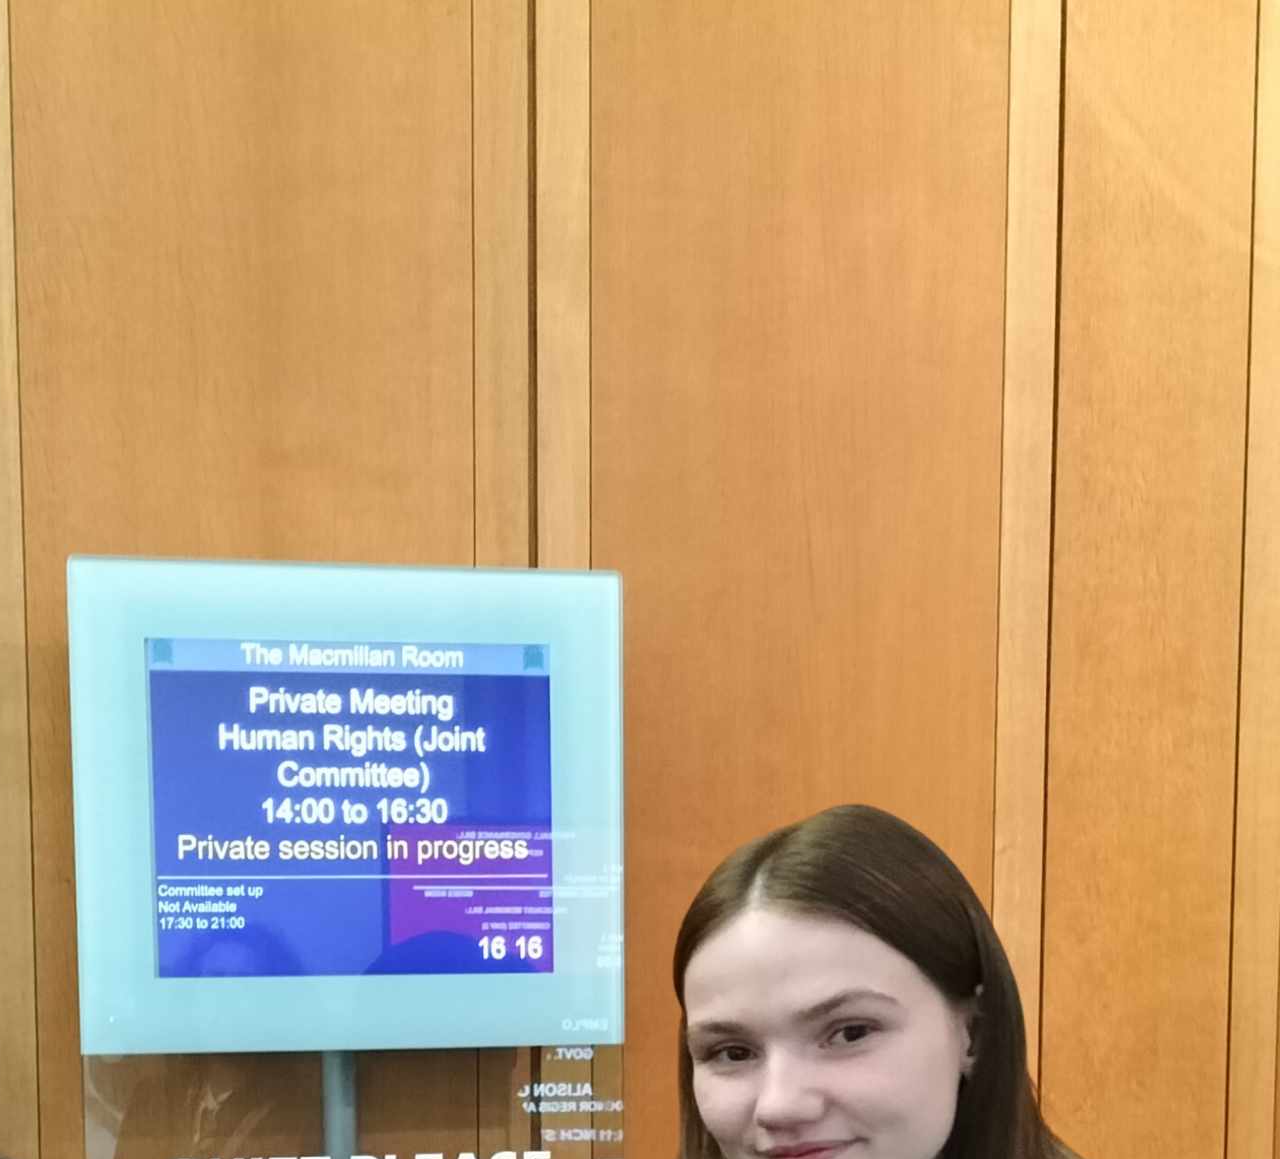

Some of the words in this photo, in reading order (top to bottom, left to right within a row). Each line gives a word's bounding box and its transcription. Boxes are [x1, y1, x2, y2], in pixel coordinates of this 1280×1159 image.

[240, 642, 283, 665] The
[288, 643, 395, 667] Macmillan
[401, 645, 464, 668] Room
[249, 686, 342, 714] Private
[350, 687, 454, 721] Meeting
[218, 723, 315, 751] Human
[323, 724, 407, 757] Rights
[414, 725, 486, 757] (Joint
[277, 760, 430, 794] Committee)
[261, 797, 335, 824] 14:00
[341, 799, 368, 824] to
[376, 798, 448, 824] 16:30
[177, 834, 271, 860] Private
[278, 834, 378, 860] session
[386, 834, 409, 860] in
[417, 839, 529, 865] progress
[157, 884, 224, 897] Committee
[226, 885, 246, 897] set
[247, 886, 264, 898] up
[158, 901, 181, 913] Not
[182, 901, 238, 913] Available
[159, 917, 194, 930] 17:30
[195, 917, 209, 930] to
[210, 916, 246, 929] 21:00
[478, 936, 507, 960] 16
[515, 936, 543, 960] 16
